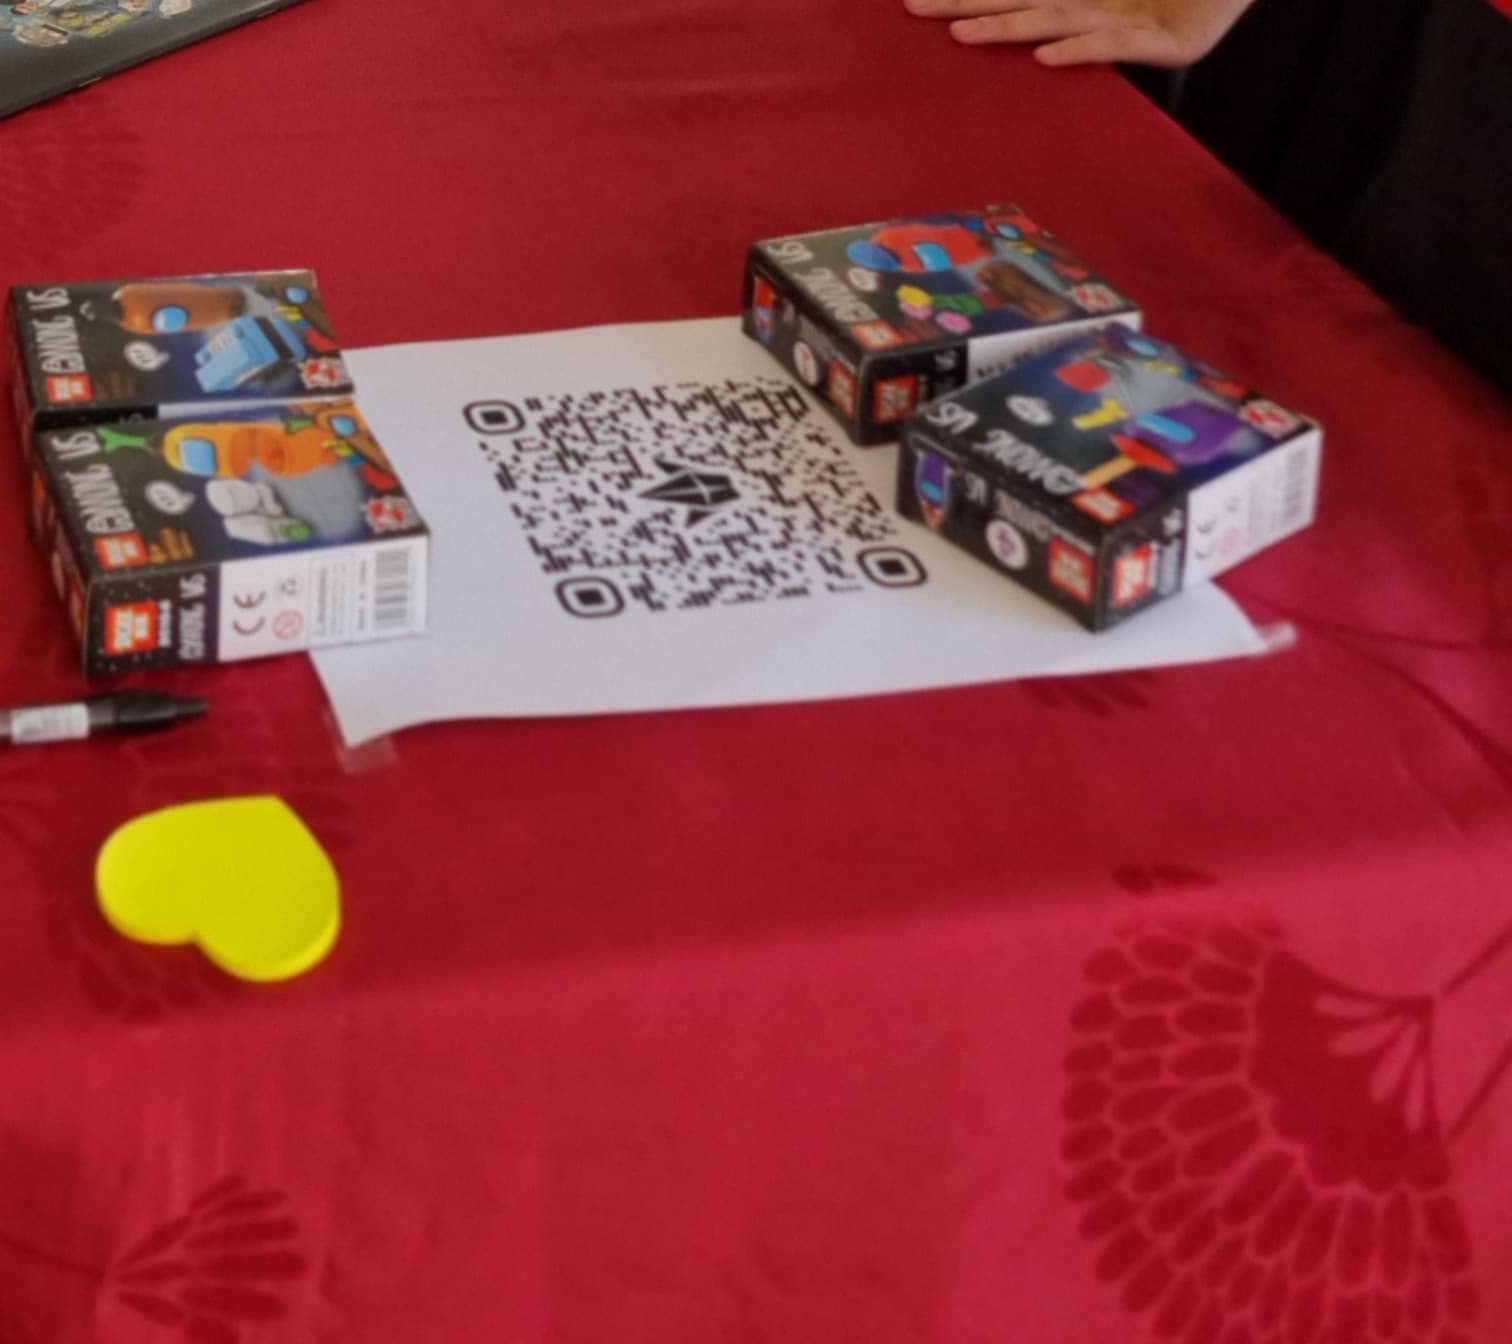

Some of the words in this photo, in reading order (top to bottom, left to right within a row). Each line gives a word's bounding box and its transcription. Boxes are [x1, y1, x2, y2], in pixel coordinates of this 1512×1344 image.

[26, 287, 72, 311] US
[31, 314, 87, 376] AMONG
[52, 430, 103, 461] US
[59, 462, 135, 534] AMONG
